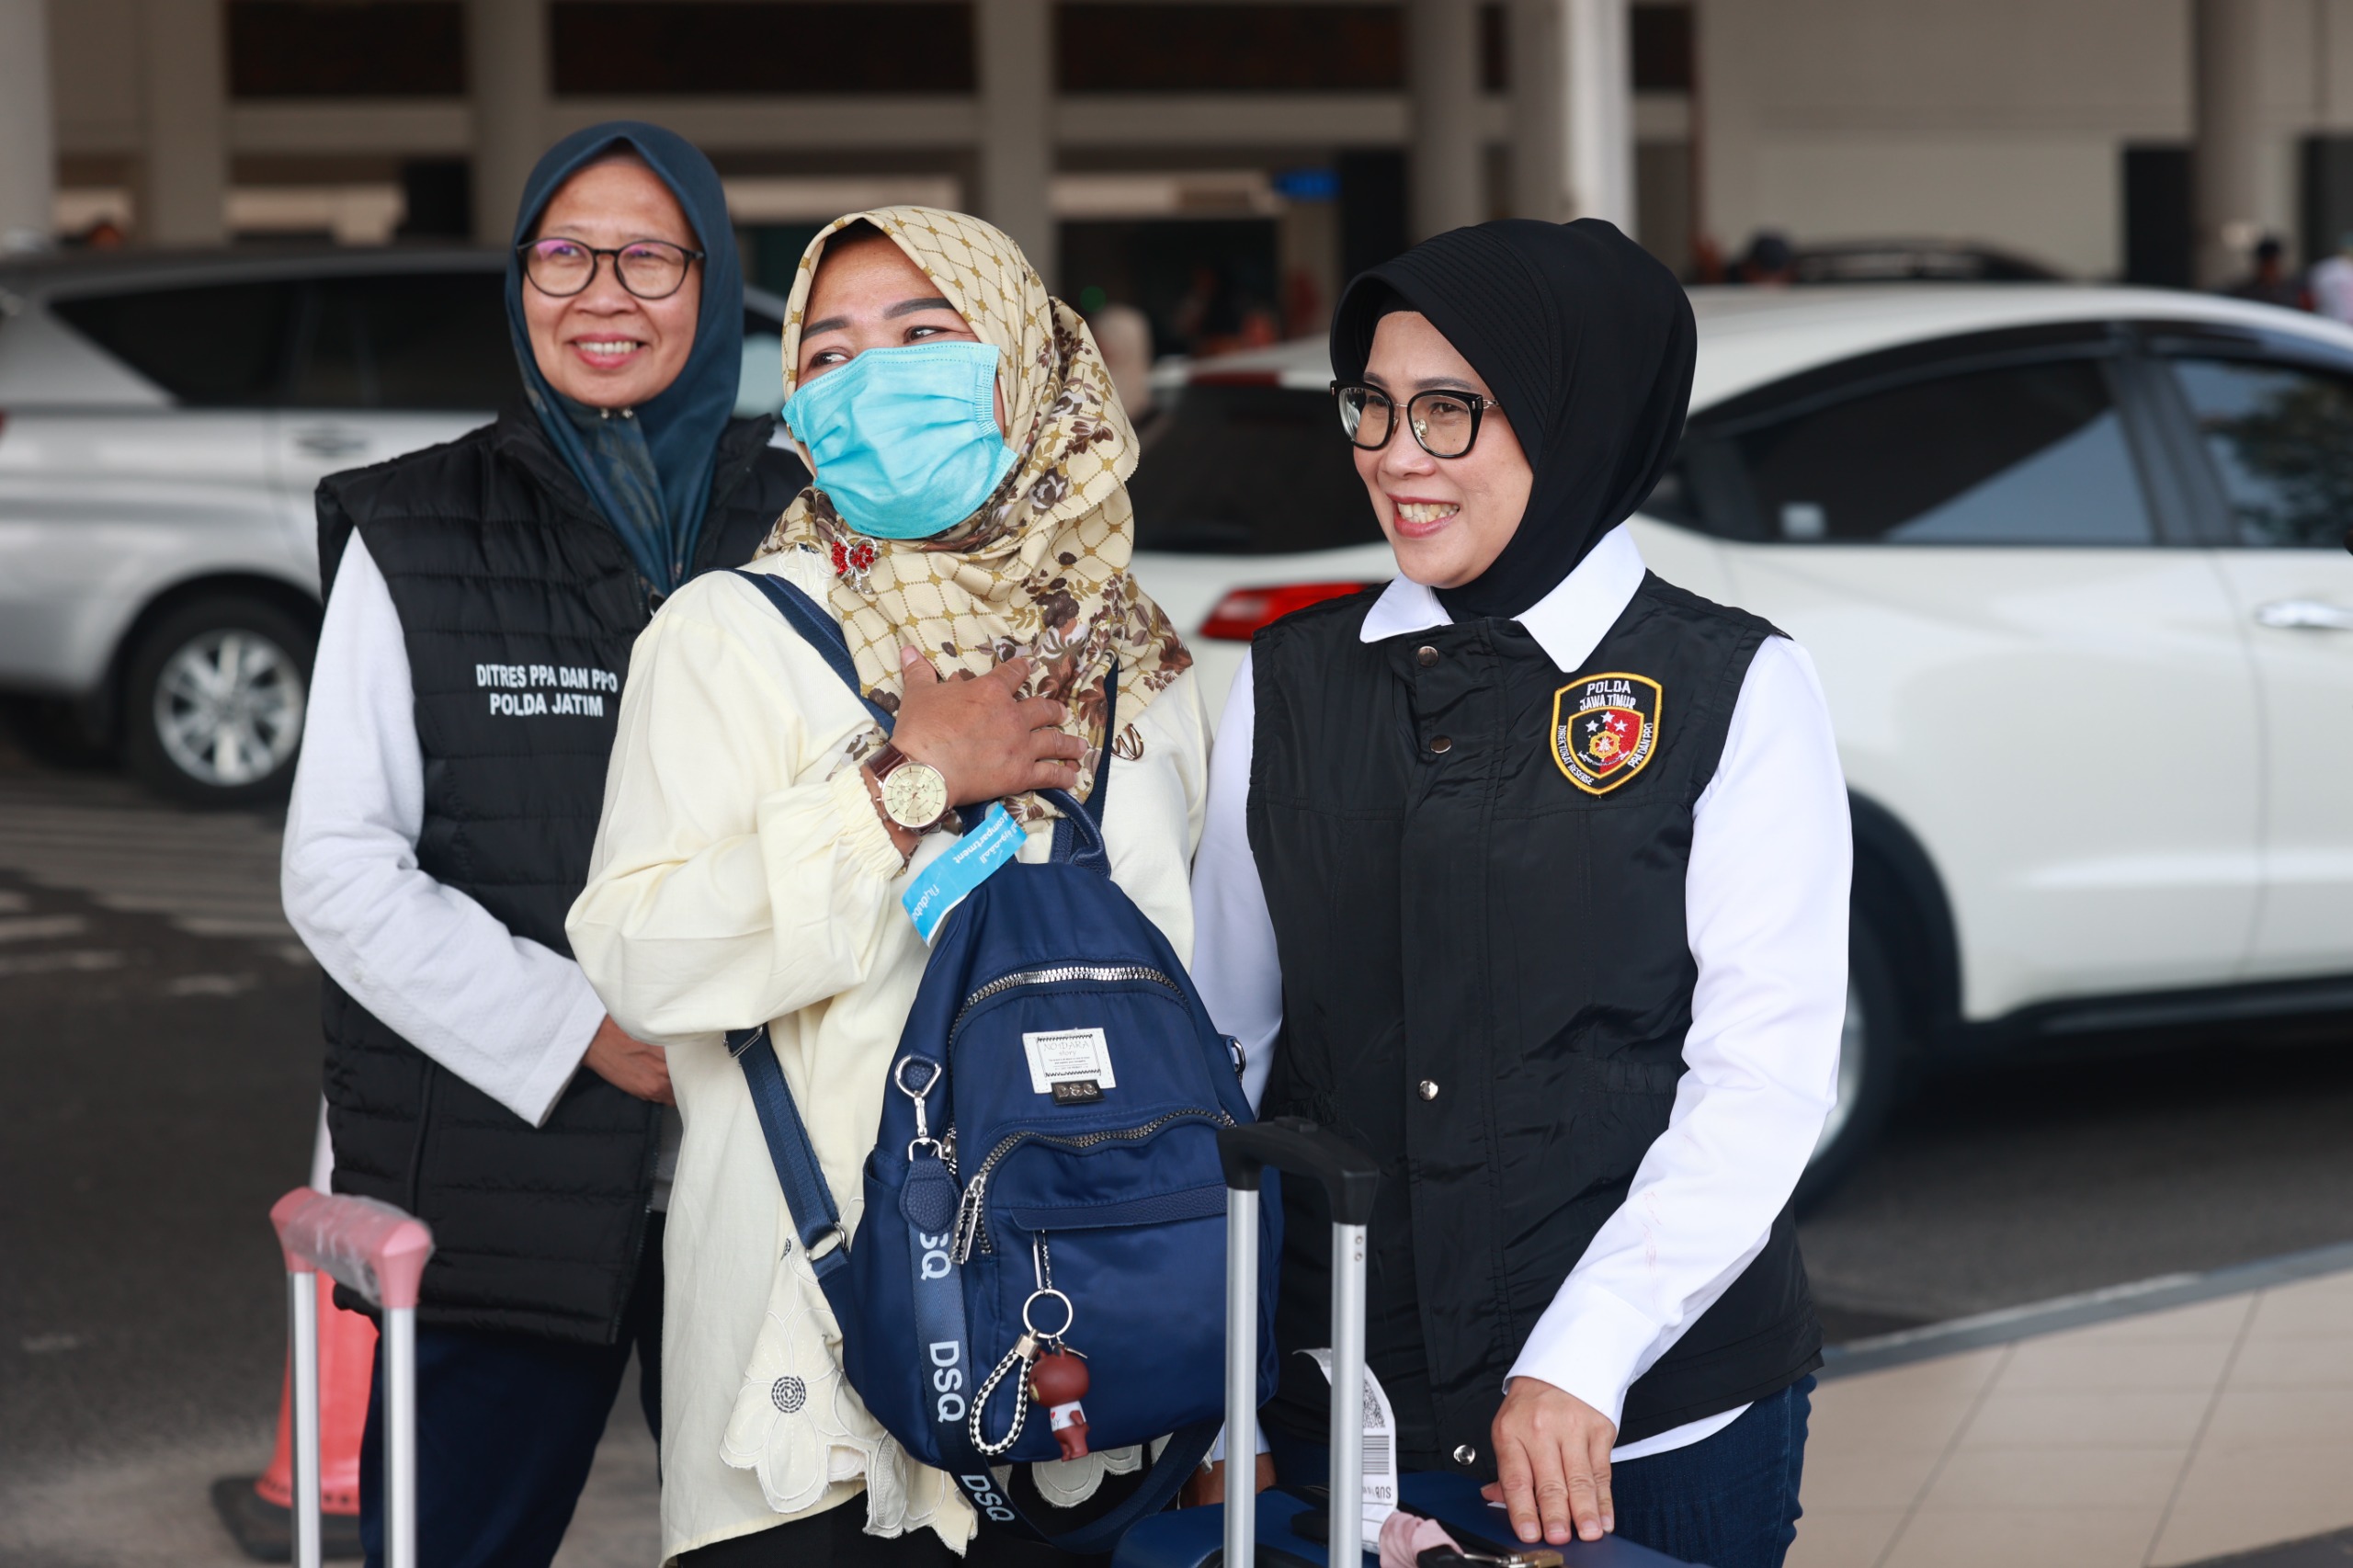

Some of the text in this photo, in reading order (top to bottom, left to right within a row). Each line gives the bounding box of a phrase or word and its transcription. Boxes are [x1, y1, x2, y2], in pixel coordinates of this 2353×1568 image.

[475, 664, 618, 693] DITRES PPA DAN PPO
[1586, 680, 1631, 696] POLDA
[490, 692, 604, 717] POLDA JATIM
[1579, 693, 1637, 711] JAWA TIMUR
[1557, 724, 1574, 765] DIREKTORAT
[1627, 722, 1654, 768] PPA DAN PPO
[953, 816, 1006, 865] compartment
[911, 883, 939, 921] flyduba
[1054, 1083, 1097, 1098] DSQ
[919, 1232, 952, 1281] SQ
[929, 1340, 966, 1424] DSQ
[961, 1474, 1016, 1523] DSQ
